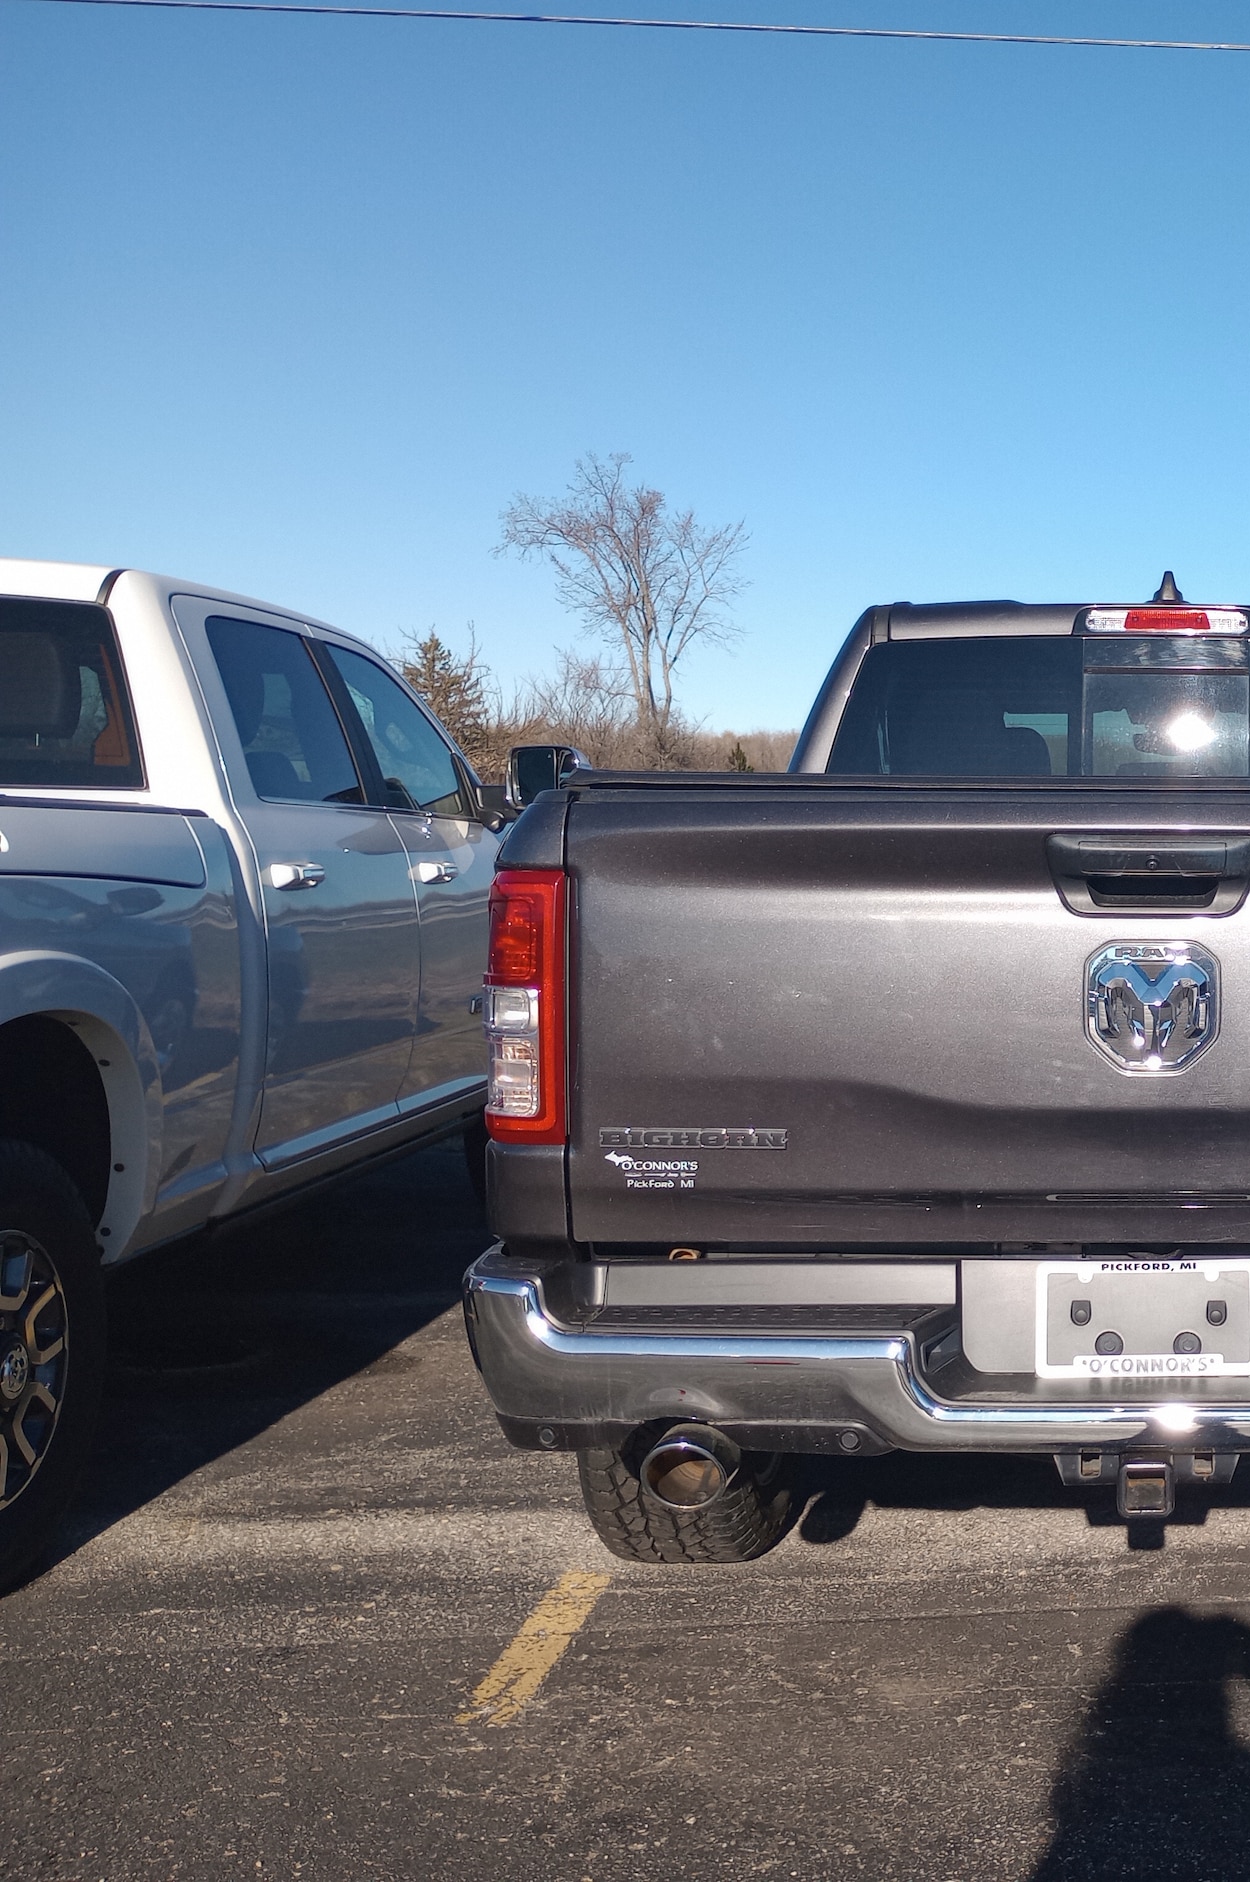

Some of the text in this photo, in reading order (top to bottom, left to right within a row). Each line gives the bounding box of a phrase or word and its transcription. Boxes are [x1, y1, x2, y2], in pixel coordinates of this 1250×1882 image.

[1115, 947, 1190, 957] RAM
[621, 1160, 699, 1171] O'CONNOR'S
[680, 1180, 695, 1188] MI
[1101, 1262, 1197, 1272] PICKFORD, MI
